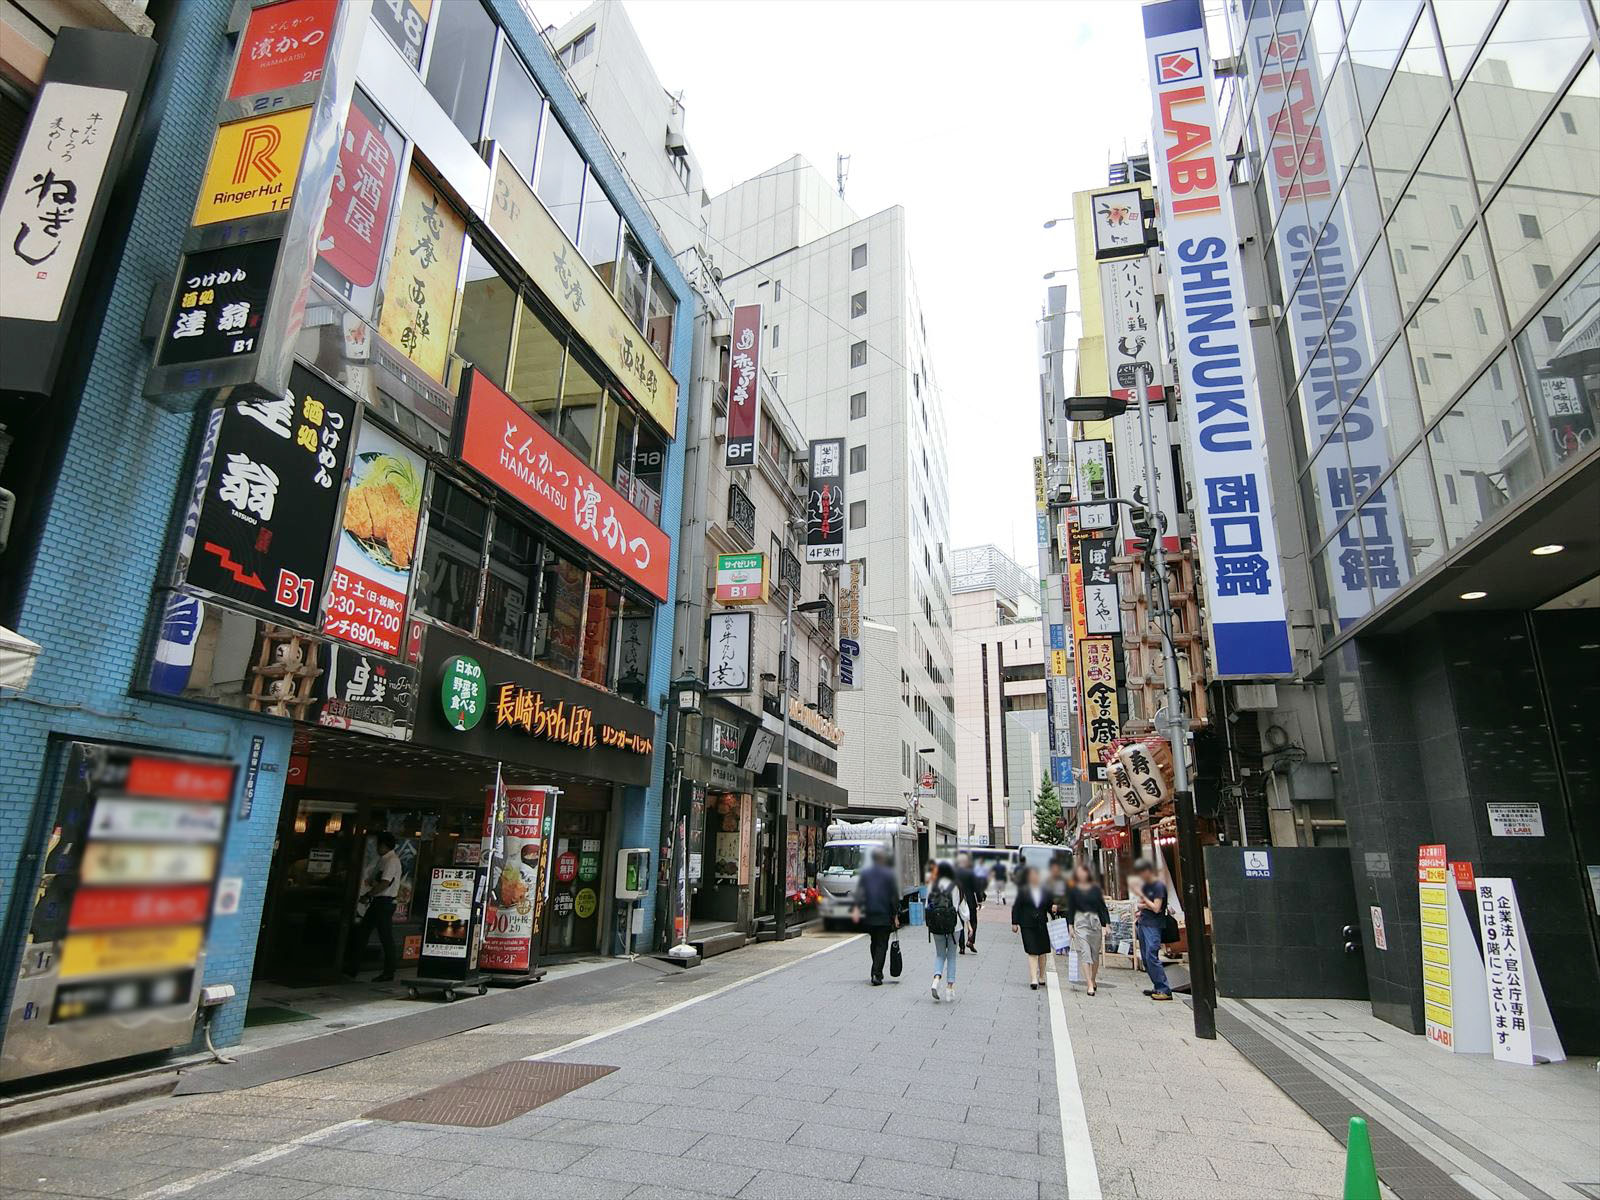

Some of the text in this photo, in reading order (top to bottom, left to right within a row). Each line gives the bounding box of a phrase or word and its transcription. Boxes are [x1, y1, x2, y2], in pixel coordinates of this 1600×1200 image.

[250, 30, 325, 60] 濱かつ
[302, 68, 322, 83] 2F
[253, 96, 283, 111] 2F
[47, 117, 66, 152] 麦めし
[81, 112, 103, 145] 牛たん
[1158, 85, 1222, 219] LABI
[213, 182, 283, 206] Ringer Hut
[344, 130, 389, 244] 居酒屋
[13, 167, 78, 266] ねぎし
[270, 196, 292, 212] 1F
[186, 268, 247, 289] つけめん
[181, 288, 215, 308] 酒処
[172, 301, 251, 340] 達翁
[232, 337, 254, 354] B1
[1177, 236, 1252, 452] SHINJUKU
[297, 394, 326, 454] 酒処
[313, 409, 345, 490] つけめん
[503, 419, 570, 489] とんかつ
[727, 442, 753, 458] 6F
[499, 448, 568, 512] HAMAKATSU
[573, 474, 652, 570] 濱かつ
[1087, 514, 1104, 525] 5F
[1202, 473, 1272, 597] 西口館
[808, 547, 841, 558] 4F受付
[1101, 540, 1112, 548] 4F
[724, 560, 757, 569] サイゼリヤ
[275, 566, 316, 615] B1
[730, 586, 748, 598] B1
[455, 659, 482, 679] 日本の
[839, 638, 861, 686] GAIA
[1087, 644, 1099, 666] 酒場
[1100, 643, 1112, 681] きんくら
[450, 694, 477, 714] 食べる
[453, 676, 479, 699] 野菜を
[496, 683, 598, 750] 長崎ちゃんぽん
[1086, 682, 1119, 744] 金の蔵
[602, 724, 653, 755] リンガーハット
[1112, 765, 1142, 808] 寿司
[1128, 748, 1162, 799] 寿司
[432, 869, 445, 880] B1
[1479, 885, 1512, 1052] 窓口は9階にございます。
[1496, 895, 1526, 1032] 企業法人・官公庁専用
[1432, 1028, 1453, 1047] LABI
